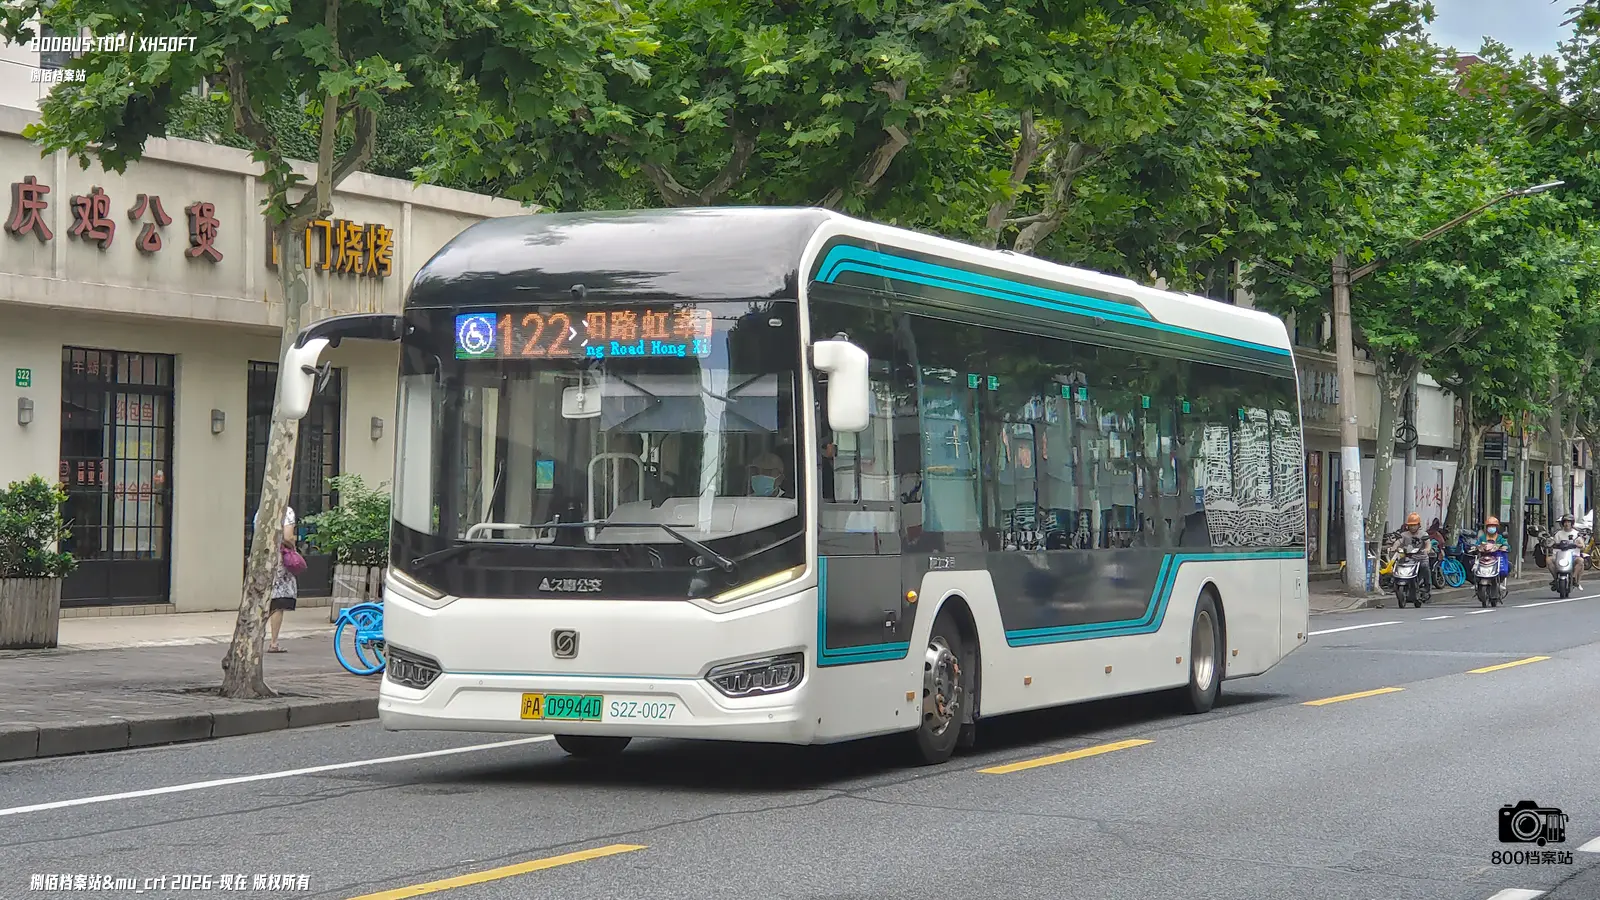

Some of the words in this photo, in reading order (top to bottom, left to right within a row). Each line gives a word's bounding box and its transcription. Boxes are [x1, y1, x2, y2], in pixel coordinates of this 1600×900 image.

[5, 175, 224, 263] 庆鸡公煲
[271, 218, 394, 277] 门烧烤
[498, 313, 570, 356] 122
[610, 340, 645, 355] Road
[651, 341, 686, 357] Hong
[692, 339, 712, 354] Xi
[17, 370, 29, 379] 322
[547, 698, 600, 717] 09944D
[610, 701, 676, 719] S2Z-0027
